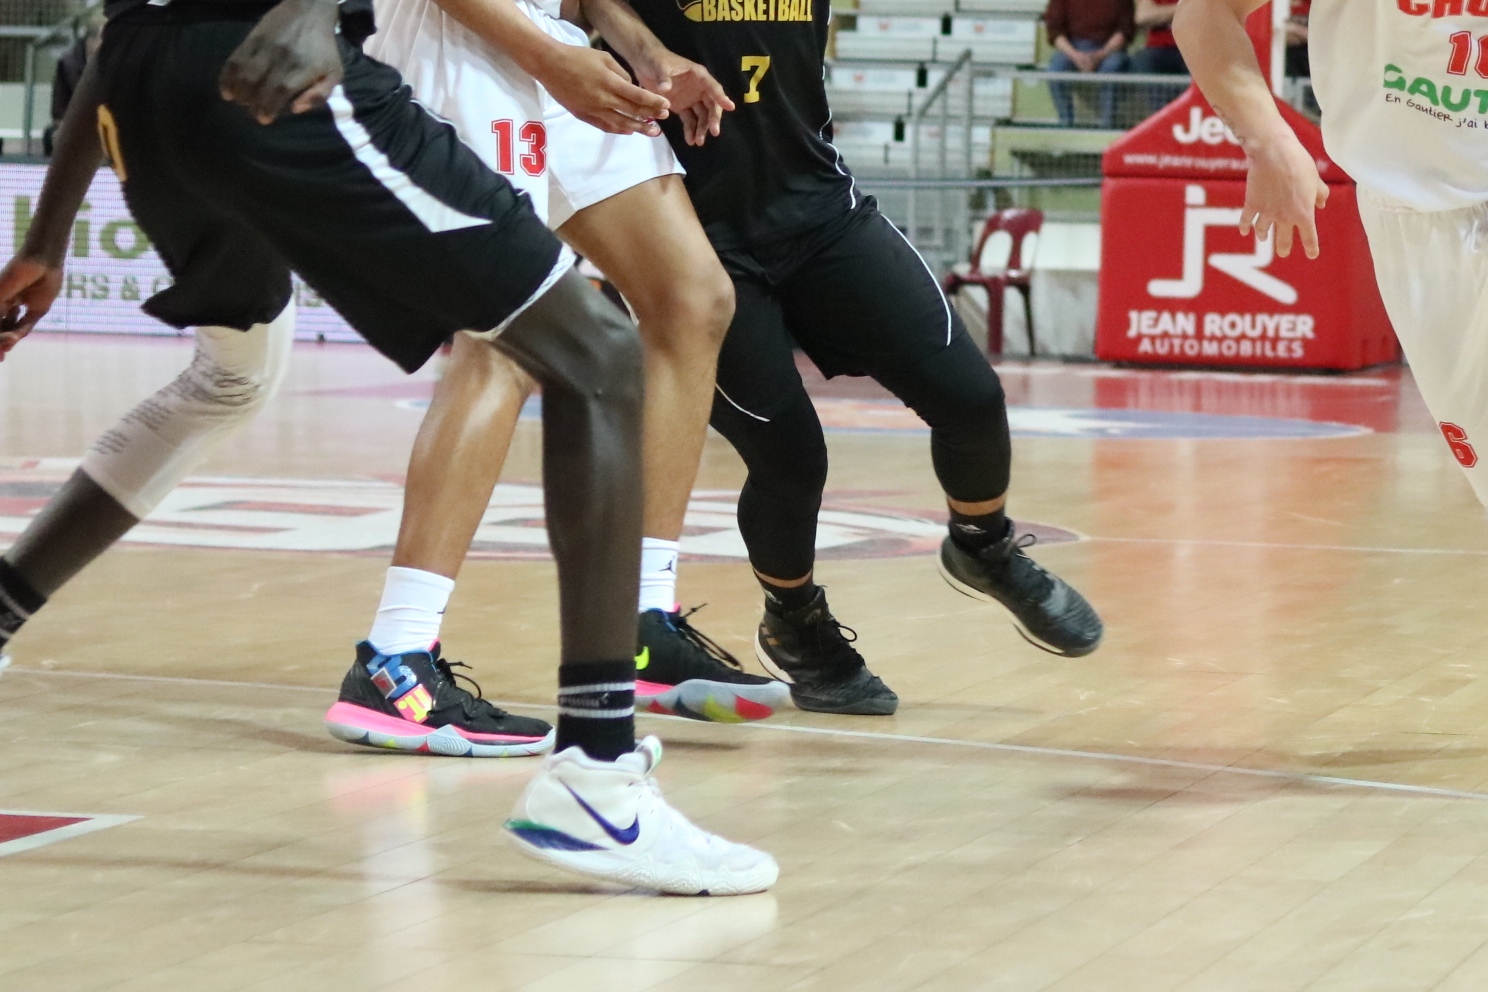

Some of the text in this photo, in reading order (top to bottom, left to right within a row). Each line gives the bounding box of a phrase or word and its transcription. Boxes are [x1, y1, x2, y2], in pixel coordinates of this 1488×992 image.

[741, 55, 770, 104] 7
[1385, 93, 1401, 104] En
[1456, 118, 1478, 129] j'ai
[491, 118, 548, 177] 13
[1127, 310, 1316, 339] JEAN ROUYER
[1138, 337, 1305, 358] AUTOMOBILES
[1439, 421, 1478, 468] 6
